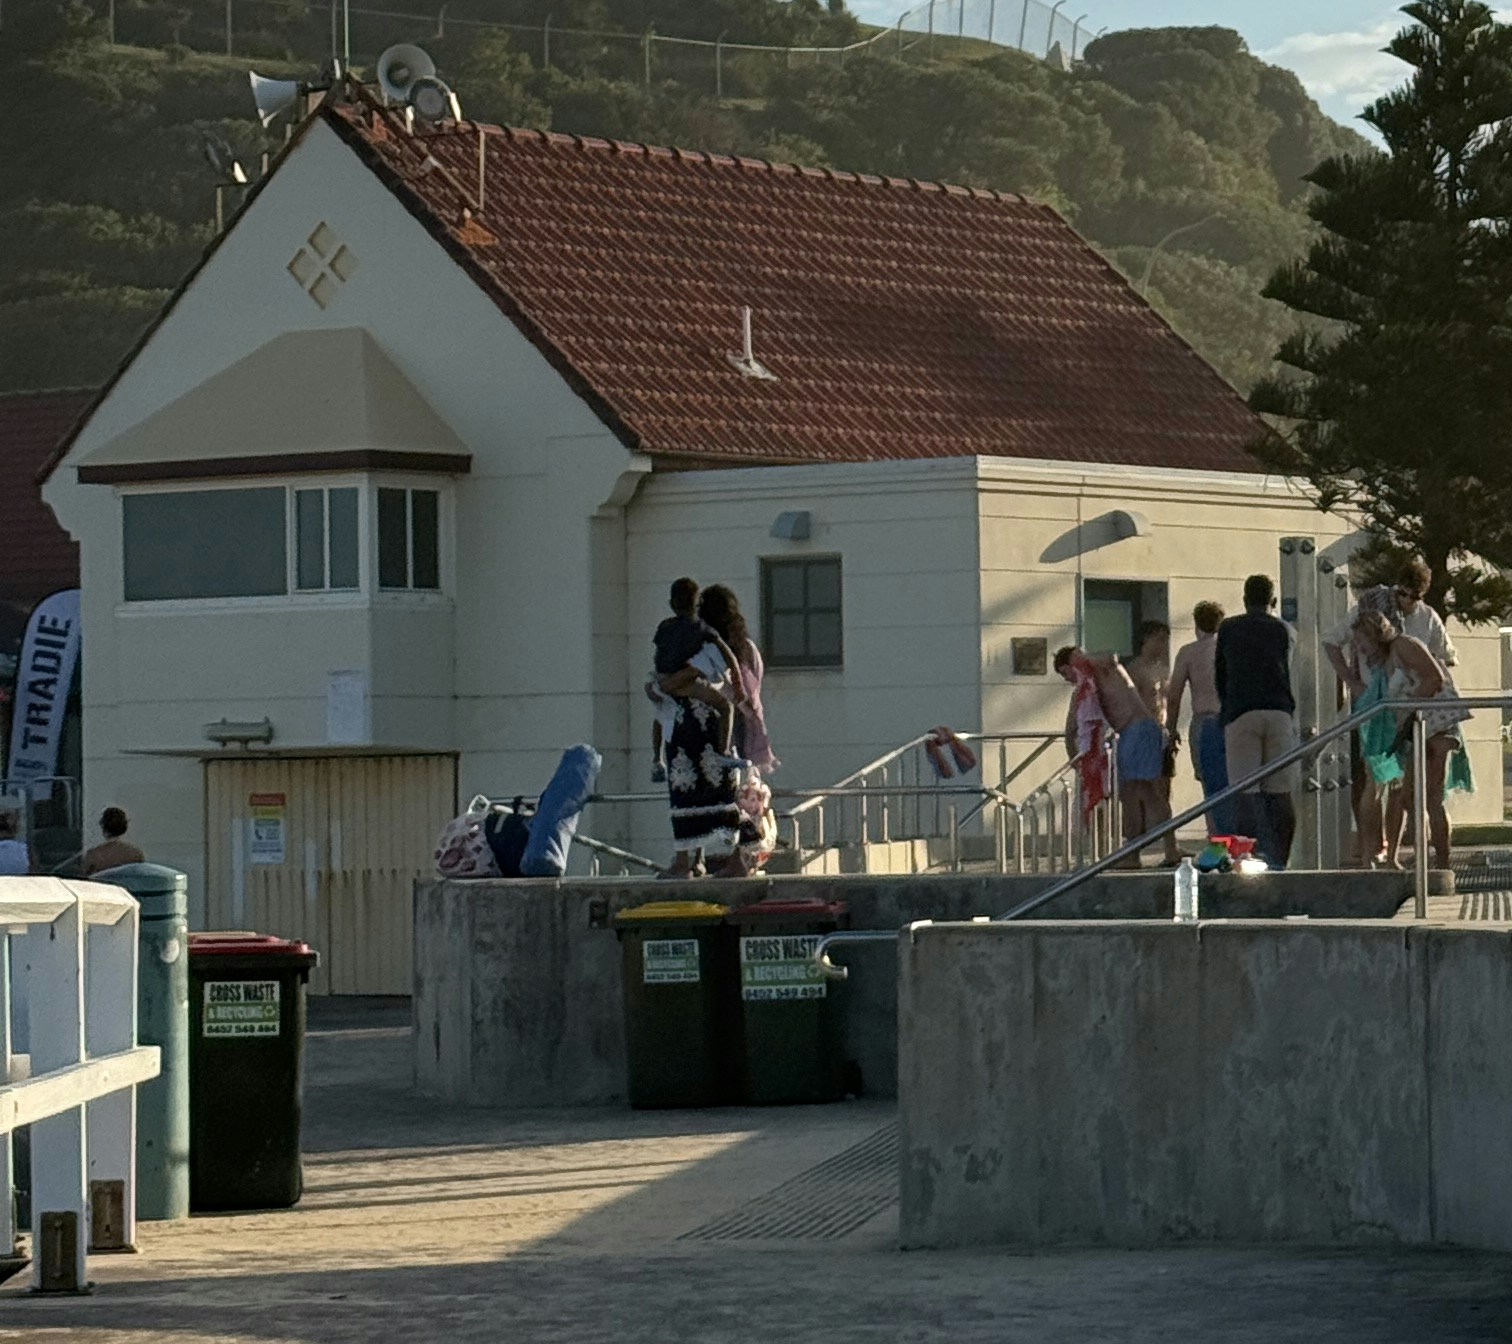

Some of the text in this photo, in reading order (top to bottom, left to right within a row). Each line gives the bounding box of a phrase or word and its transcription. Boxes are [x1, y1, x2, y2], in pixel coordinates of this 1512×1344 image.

[21, 614, 72, 750] TRADIE
[745, 939, 780, 960] CROSS
[209, 983, 275, 1002] CROSS WASTE
